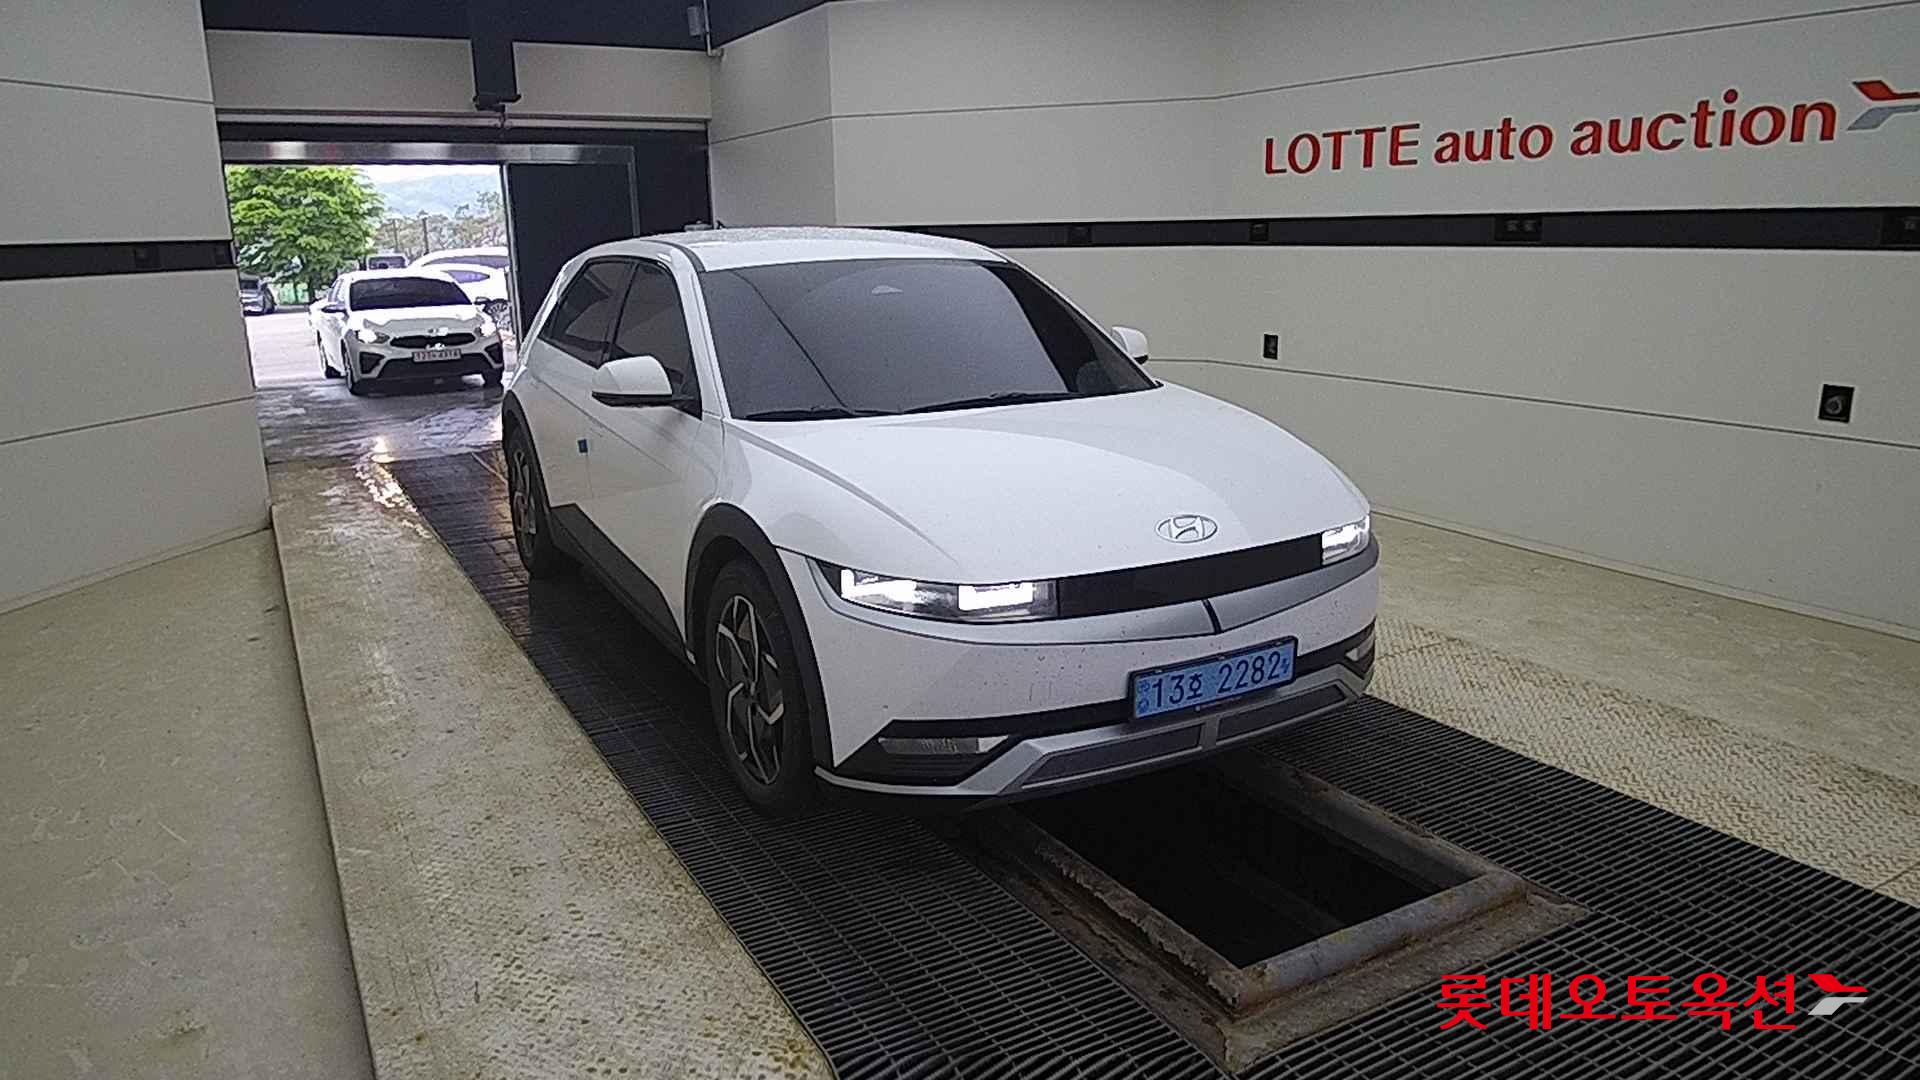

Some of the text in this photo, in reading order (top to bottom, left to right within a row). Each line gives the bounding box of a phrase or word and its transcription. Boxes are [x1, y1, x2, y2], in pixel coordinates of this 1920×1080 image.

[1264, 89, 1838, 175] LOTTE auto auction
[1153, 651, 1281, 708] 13호 2282
